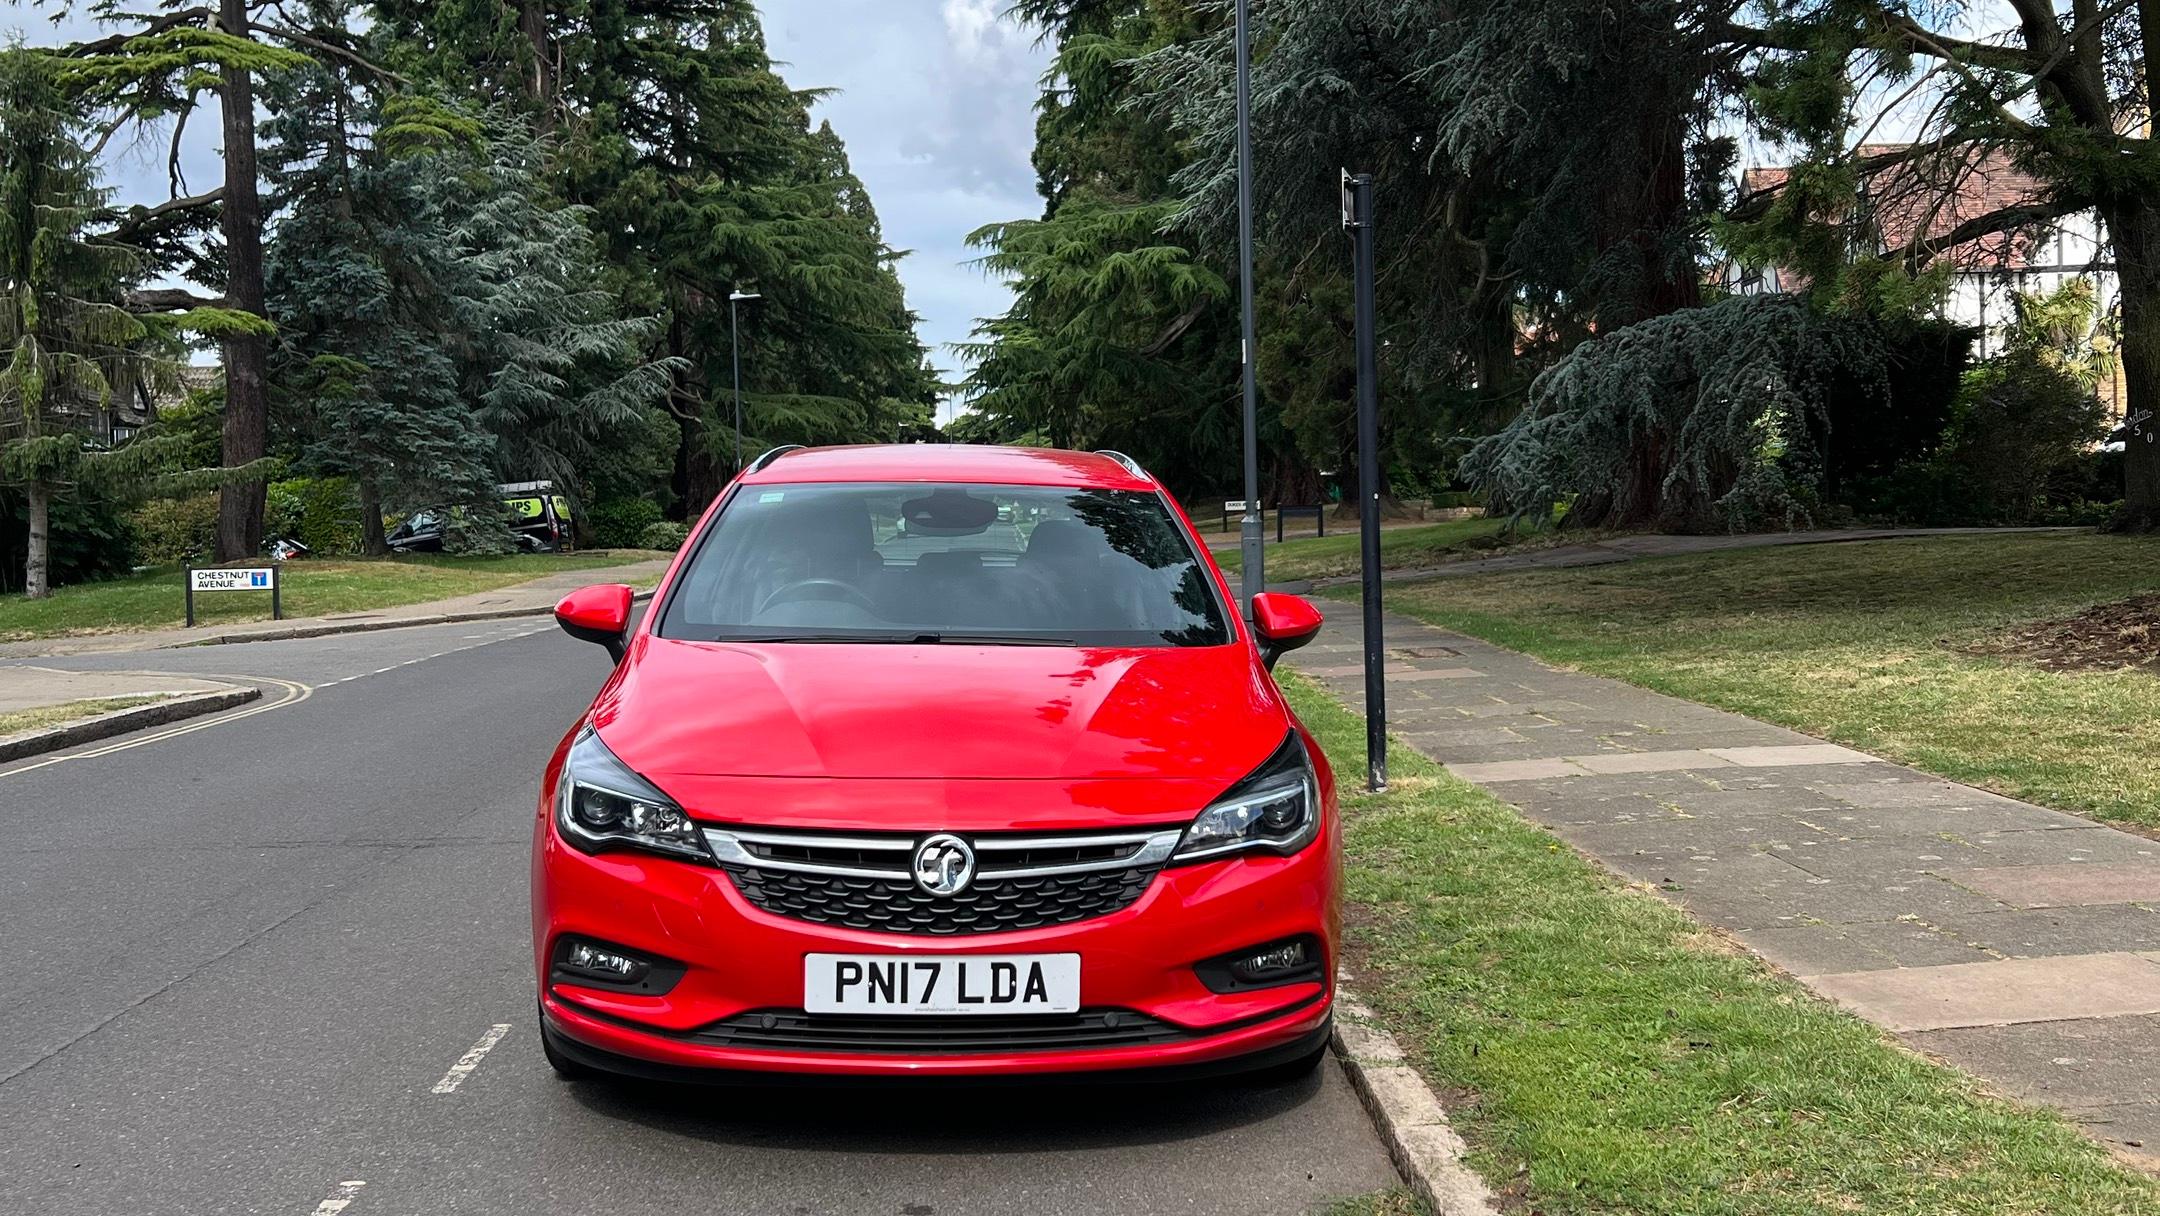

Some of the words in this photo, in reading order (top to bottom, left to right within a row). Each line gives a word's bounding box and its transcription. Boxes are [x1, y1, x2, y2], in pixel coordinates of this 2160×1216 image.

[197, 571, 249, 580] CHESTNUT
[198, 580, 235, 588] AVENUE
[835, 961, 941, 1004] PN17
[957, 961, 1049, 1004] LDA
